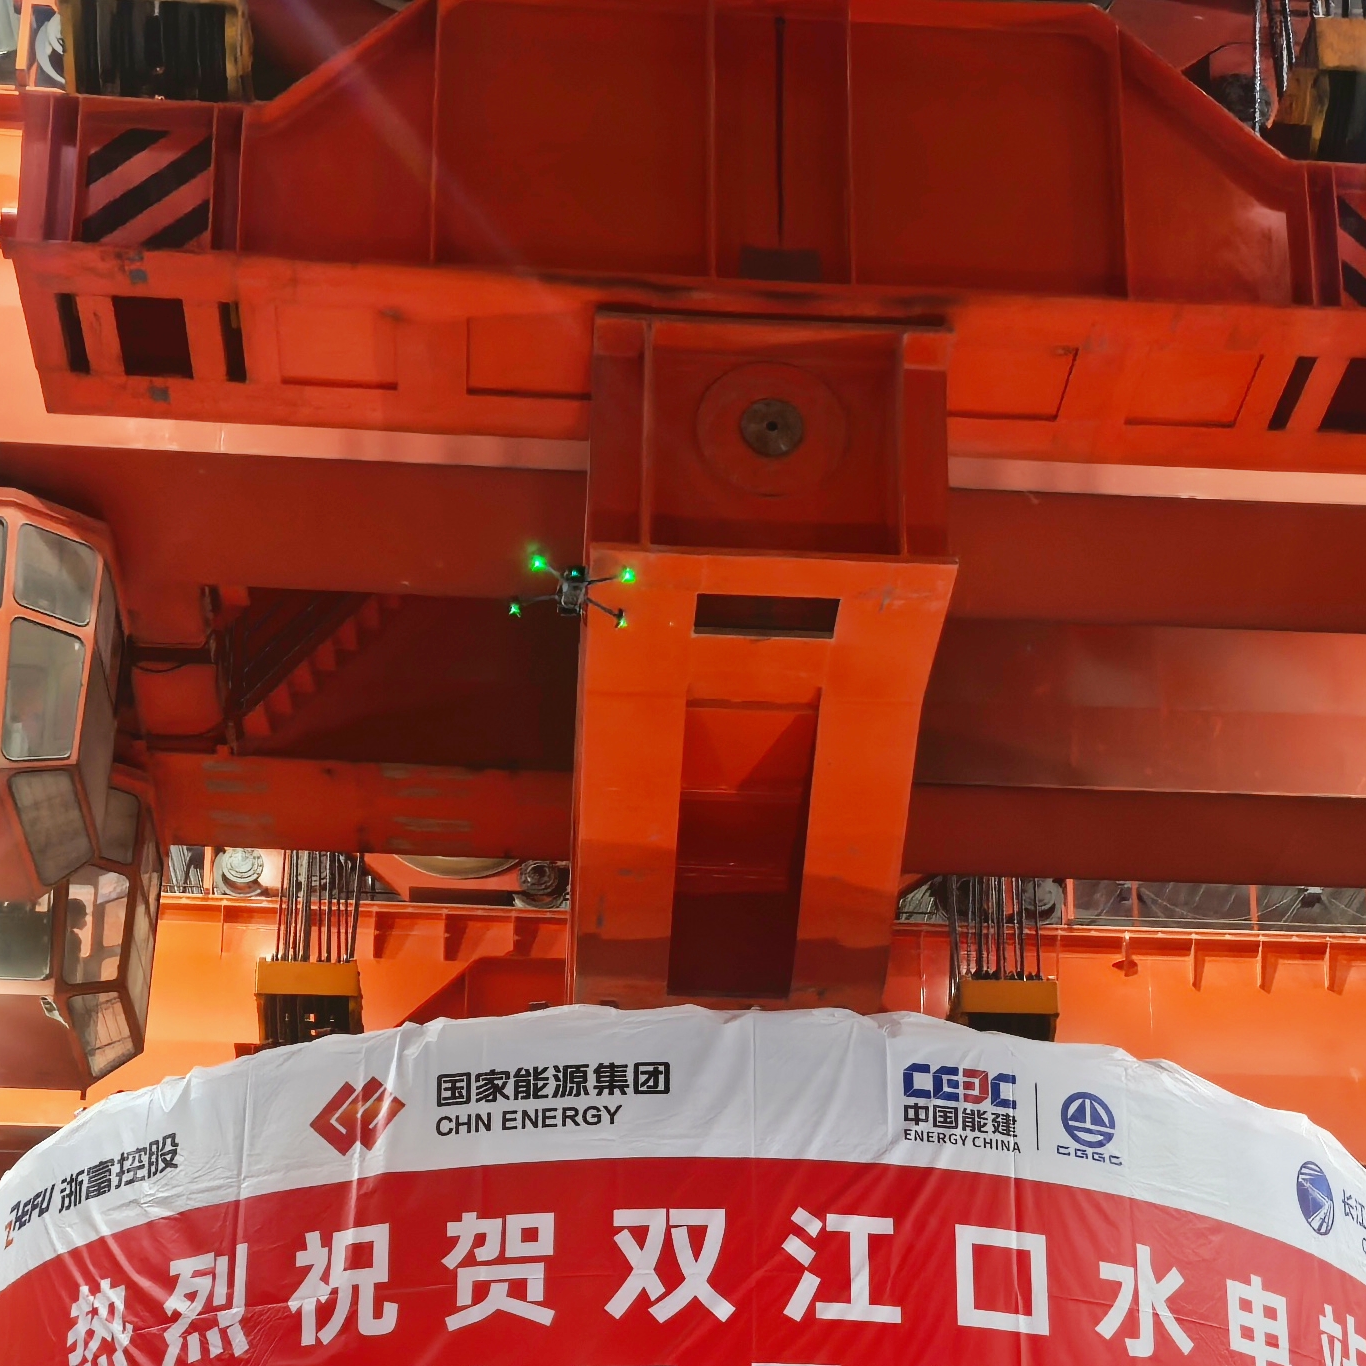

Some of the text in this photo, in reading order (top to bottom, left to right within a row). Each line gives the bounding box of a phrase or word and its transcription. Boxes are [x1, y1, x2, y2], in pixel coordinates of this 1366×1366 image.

[436, 1061, 671, 1105] 国家能源集团
[435, 1105, 623, 1137] CHN ENERGY
[903, 1103, 1018, 1137] 中国能建
[904, 1128, 1021, 1154] ENERGY CHINA
[1056, 1144, 1123, 1167] CGGC
[58, 1132, 180, 1214] 浙富控股
